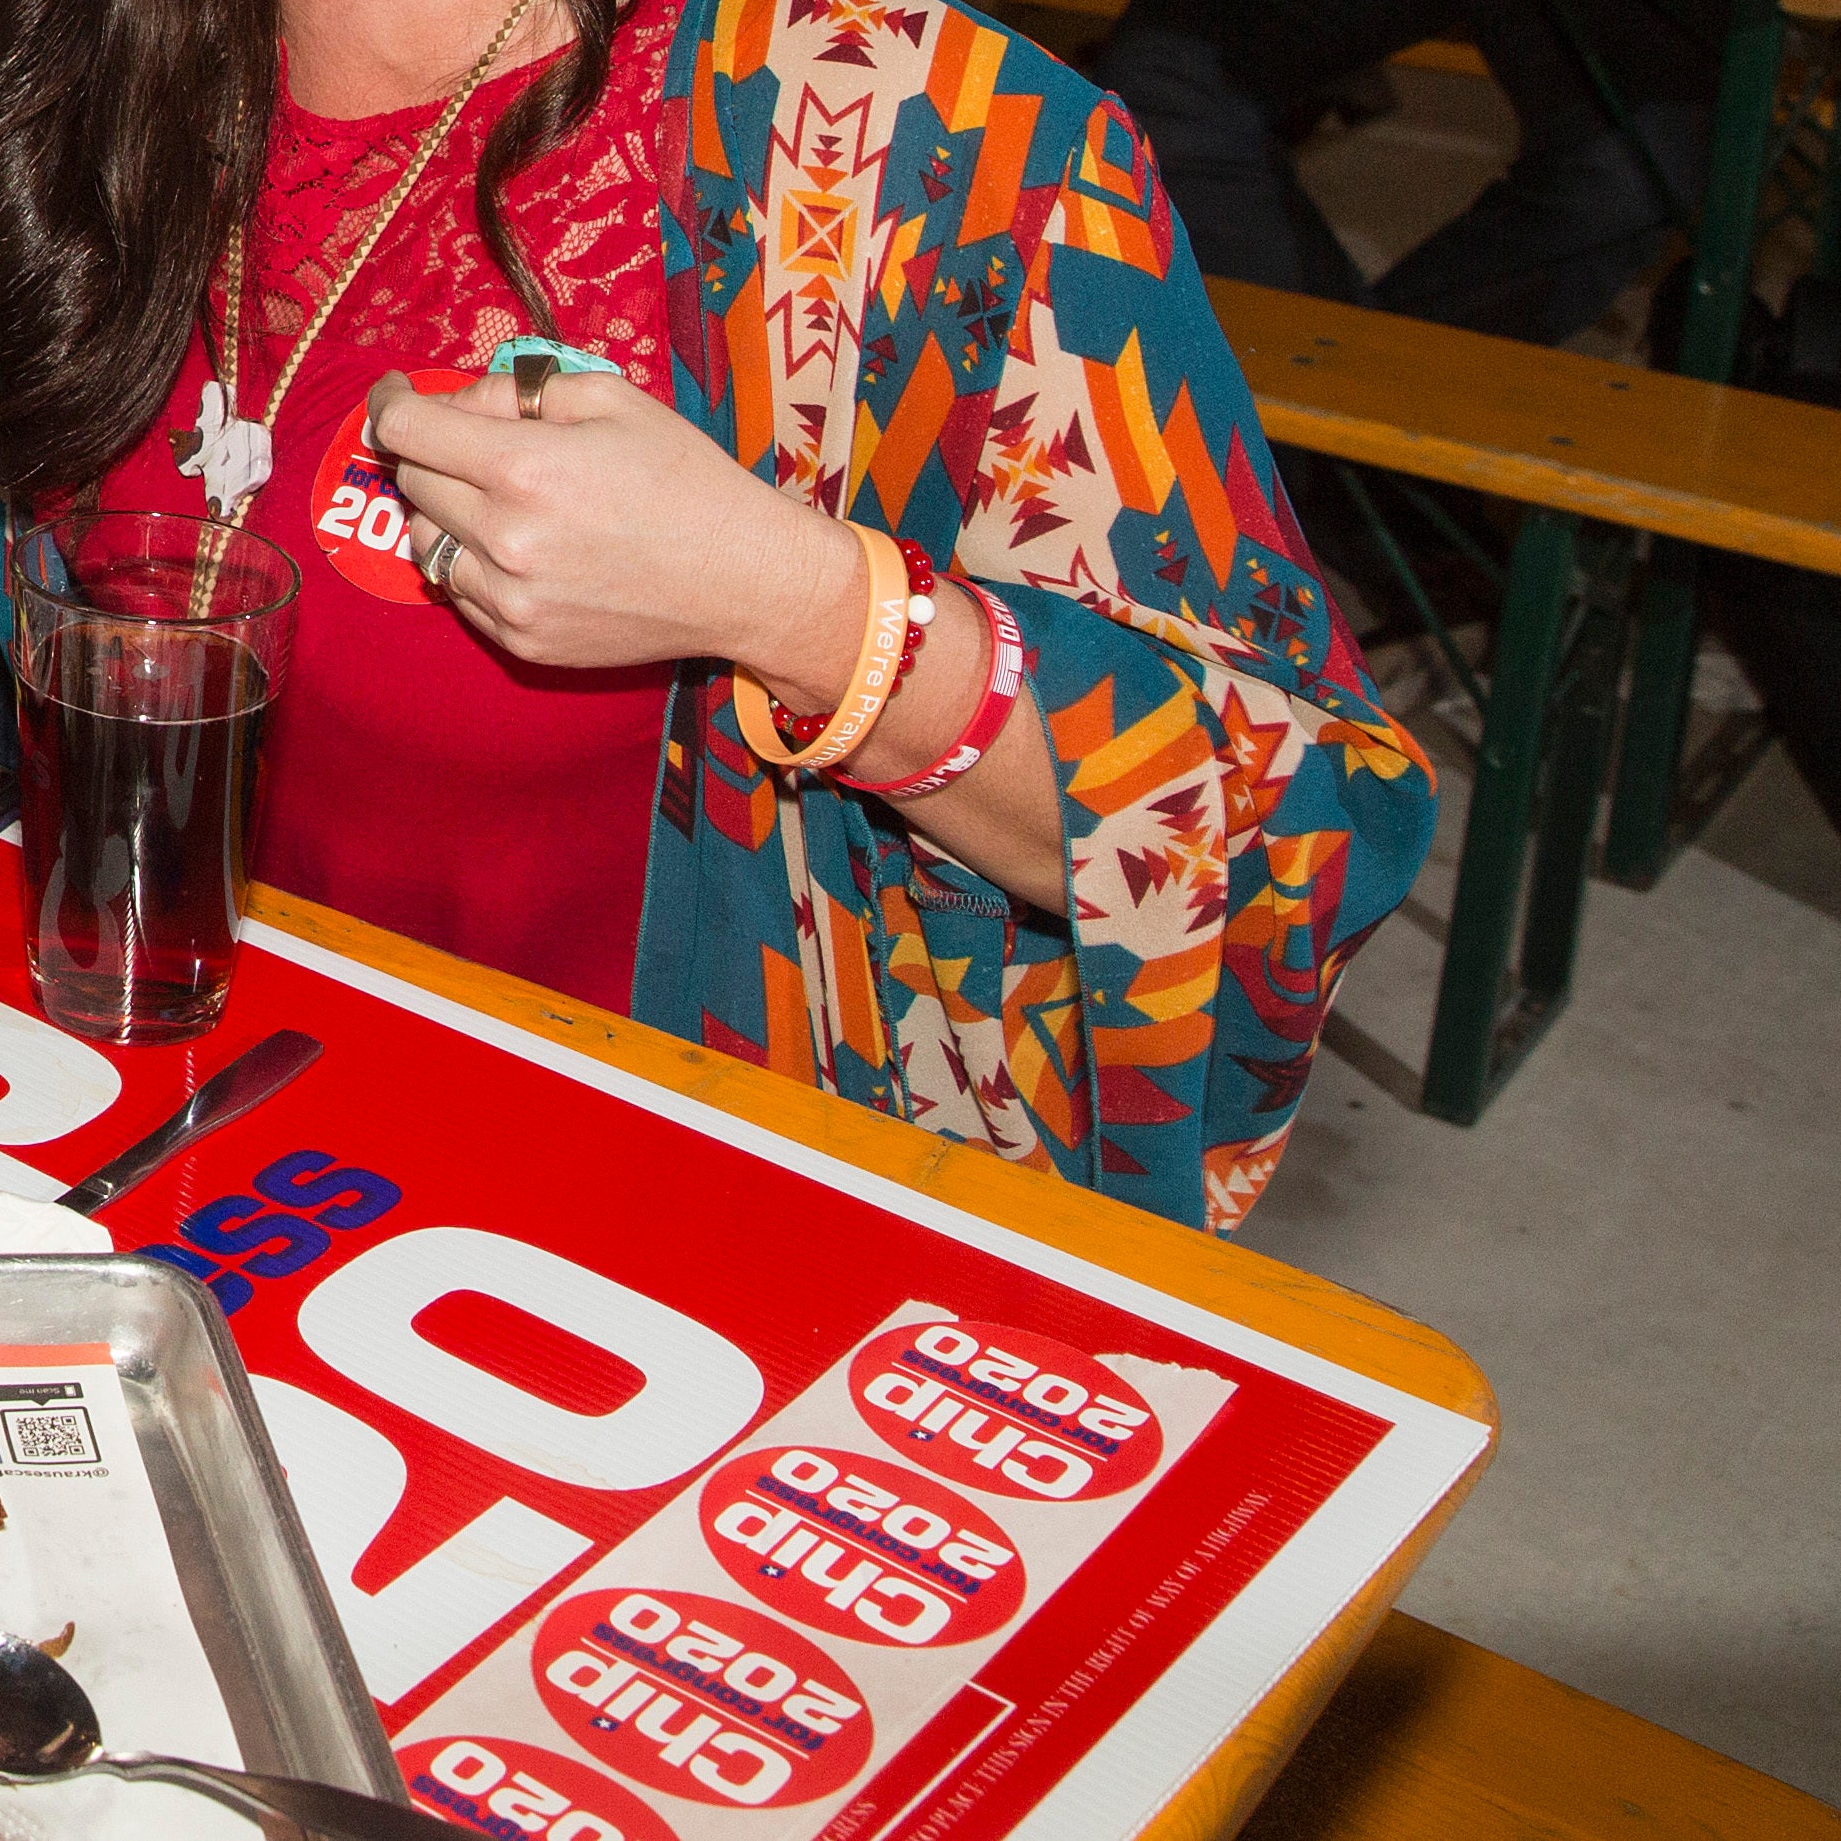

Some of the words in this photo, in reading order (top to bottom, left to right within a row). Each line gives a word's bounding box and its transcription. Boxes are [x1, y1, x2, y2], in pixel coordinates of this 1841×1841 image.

[342, 463, 379, 489] for
[317, 485, 413, 562] 20
[866, 597, 905, 688] We're
[900, 1349, 1062, 1428] congress
[914, 1325, 1150, 1442] 2020
[863, 1372, 1094, 1499] Chip
[1062, 1425, 1121, 1455] for
[755, 1475, 921, 1561] congress
[771, 1449, 1015, 1581] 2020
[714, 1501, 952, 1645] Chip
[920, 1561, 983, 1595] for
[1145, 1575, 1186, 1608] WAY
[591, 1622, 763, 1716] congress
[609, 1593, 863, 1735] 2020
[545, 1650, 793, 1806] Chip
[762, 1715, 825, 1751] for
[429, 1740, 629, 1841] 020
